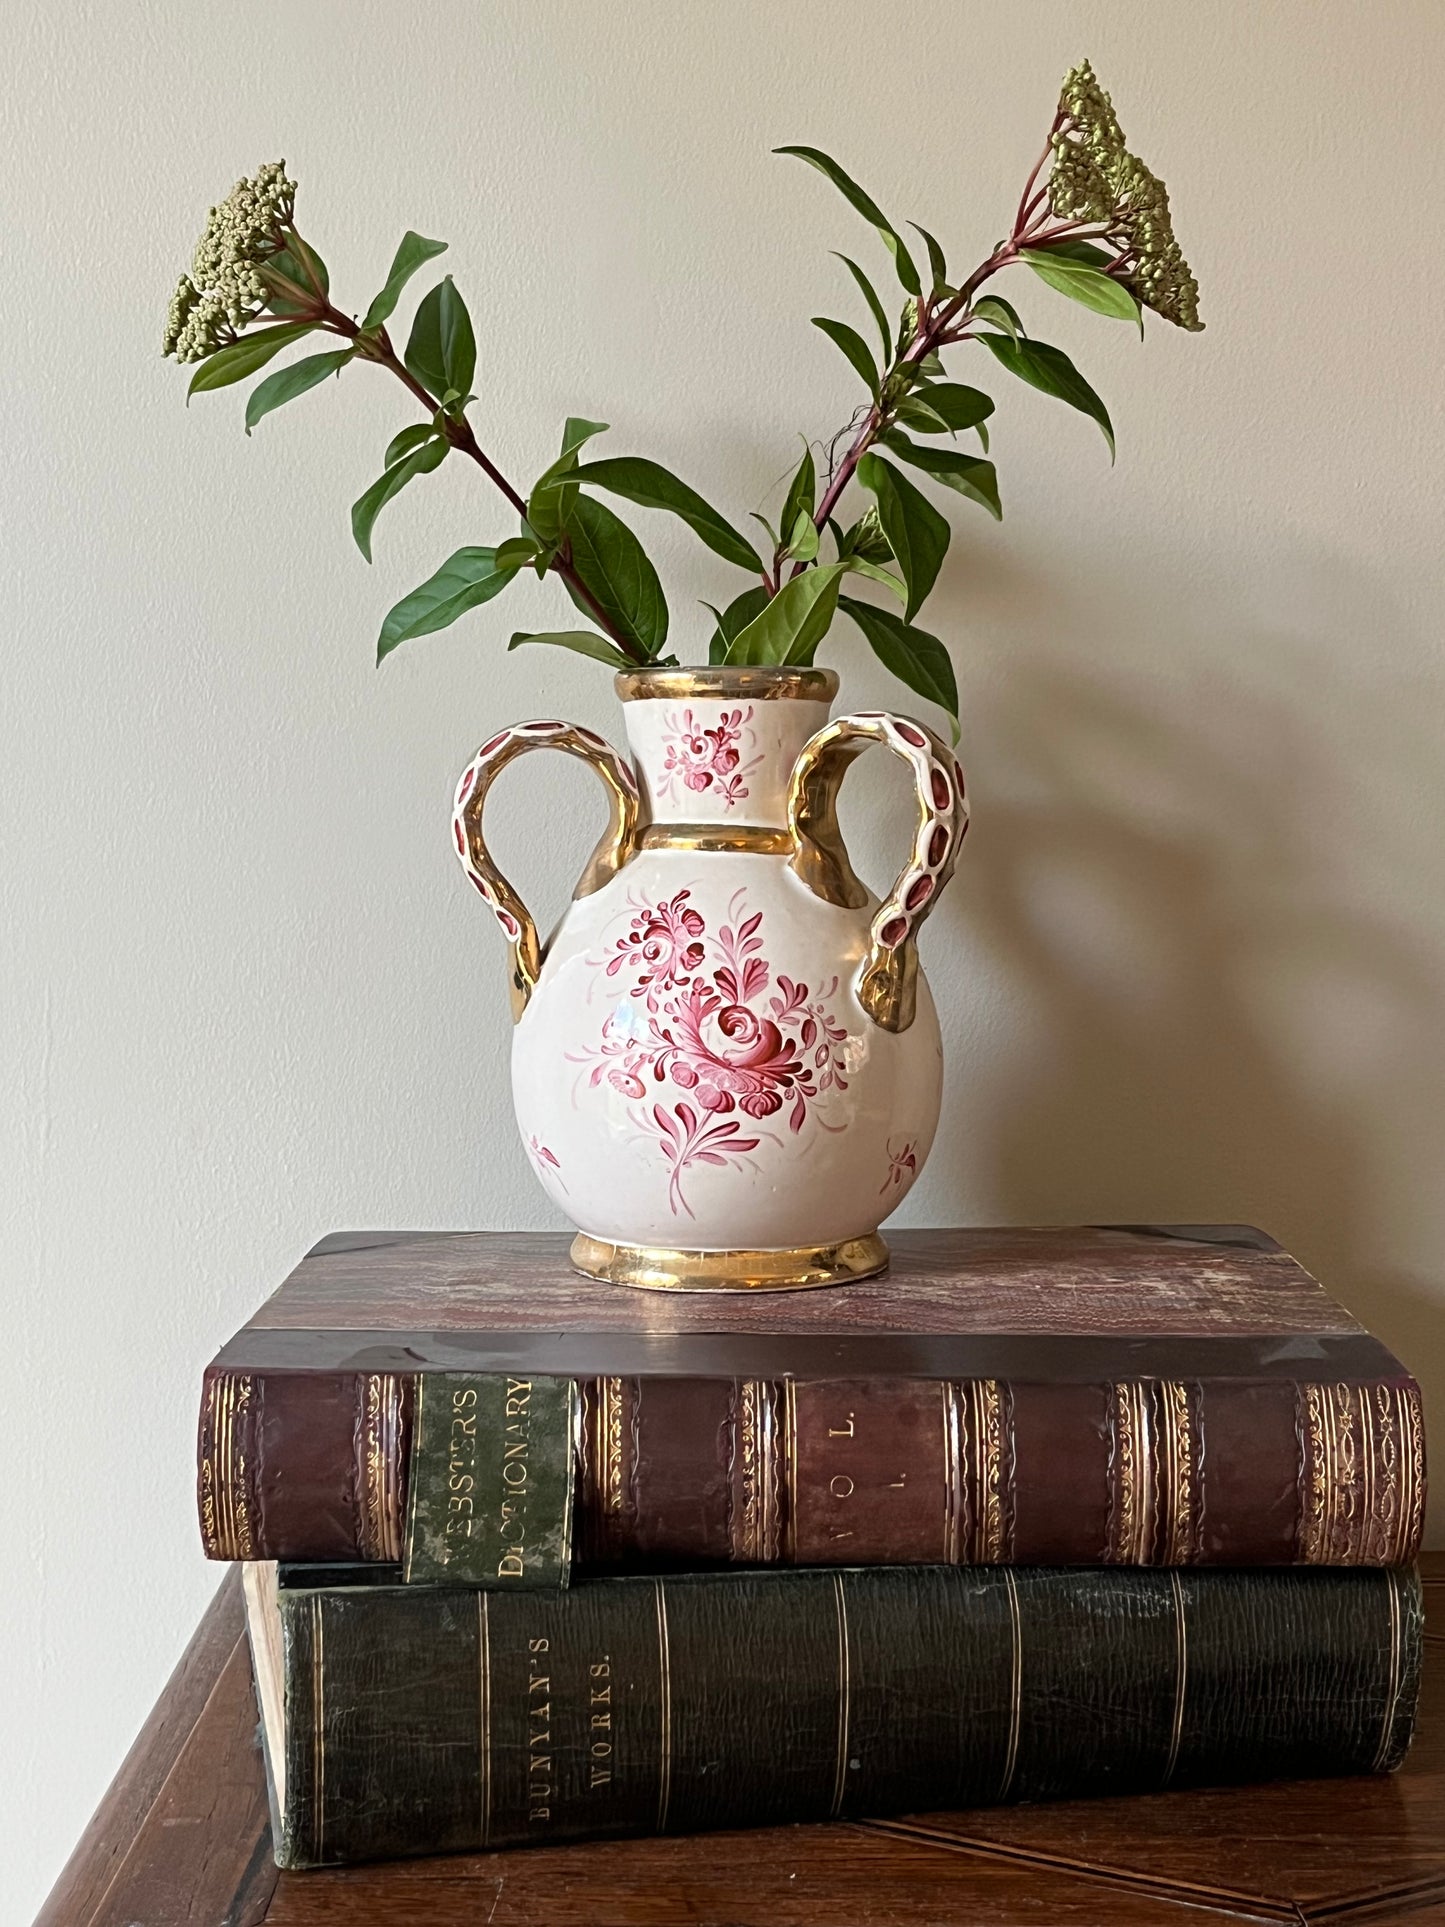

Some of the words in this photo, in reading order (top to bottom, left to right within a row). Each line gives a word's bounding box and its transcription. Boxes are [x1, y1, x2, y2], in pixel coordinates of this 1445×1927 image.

[443, 1389, 477, 1564] EBSTER'S
[498, 1377, 532, 1577] DICTIONARY
[529, 1638, 551, 1821] BUNYAN'S
[590, 1654, 612, 1788] WORKS.
